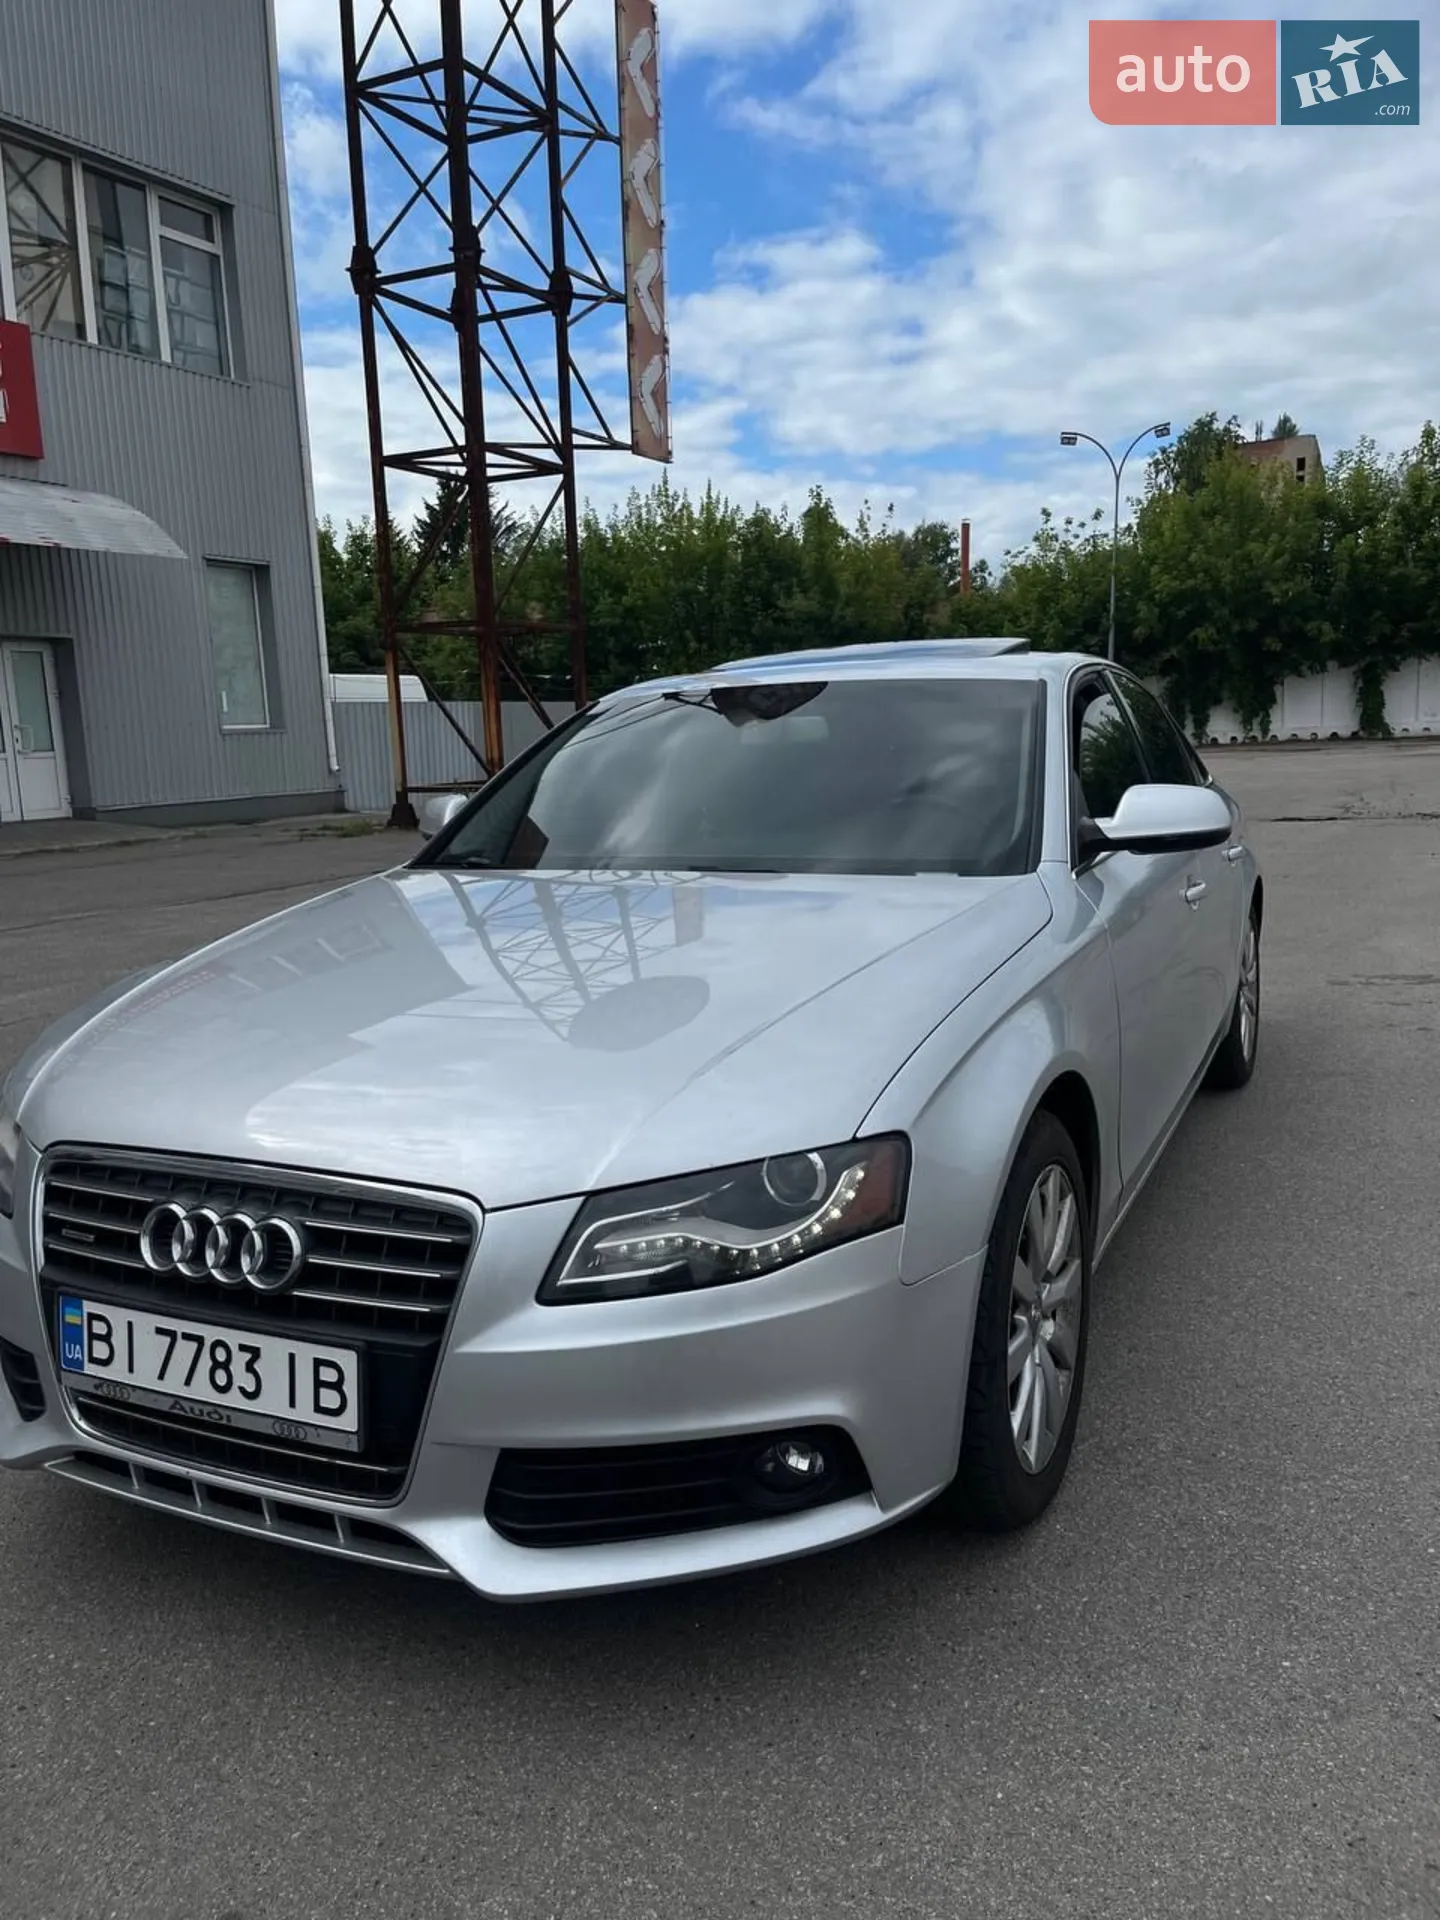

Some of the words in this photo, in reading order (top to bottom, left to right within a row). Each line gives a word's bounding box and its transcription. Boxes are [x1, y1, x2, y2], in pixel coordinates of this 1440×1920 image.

[65, 1341, 83, 1361] UA
[86, 1312, 135, 1374] BI
[154, 1326, 262, 1401] 7783
[287, 1352, 348, 1418] IB
[167, 1399, 232, 1425] Audi
